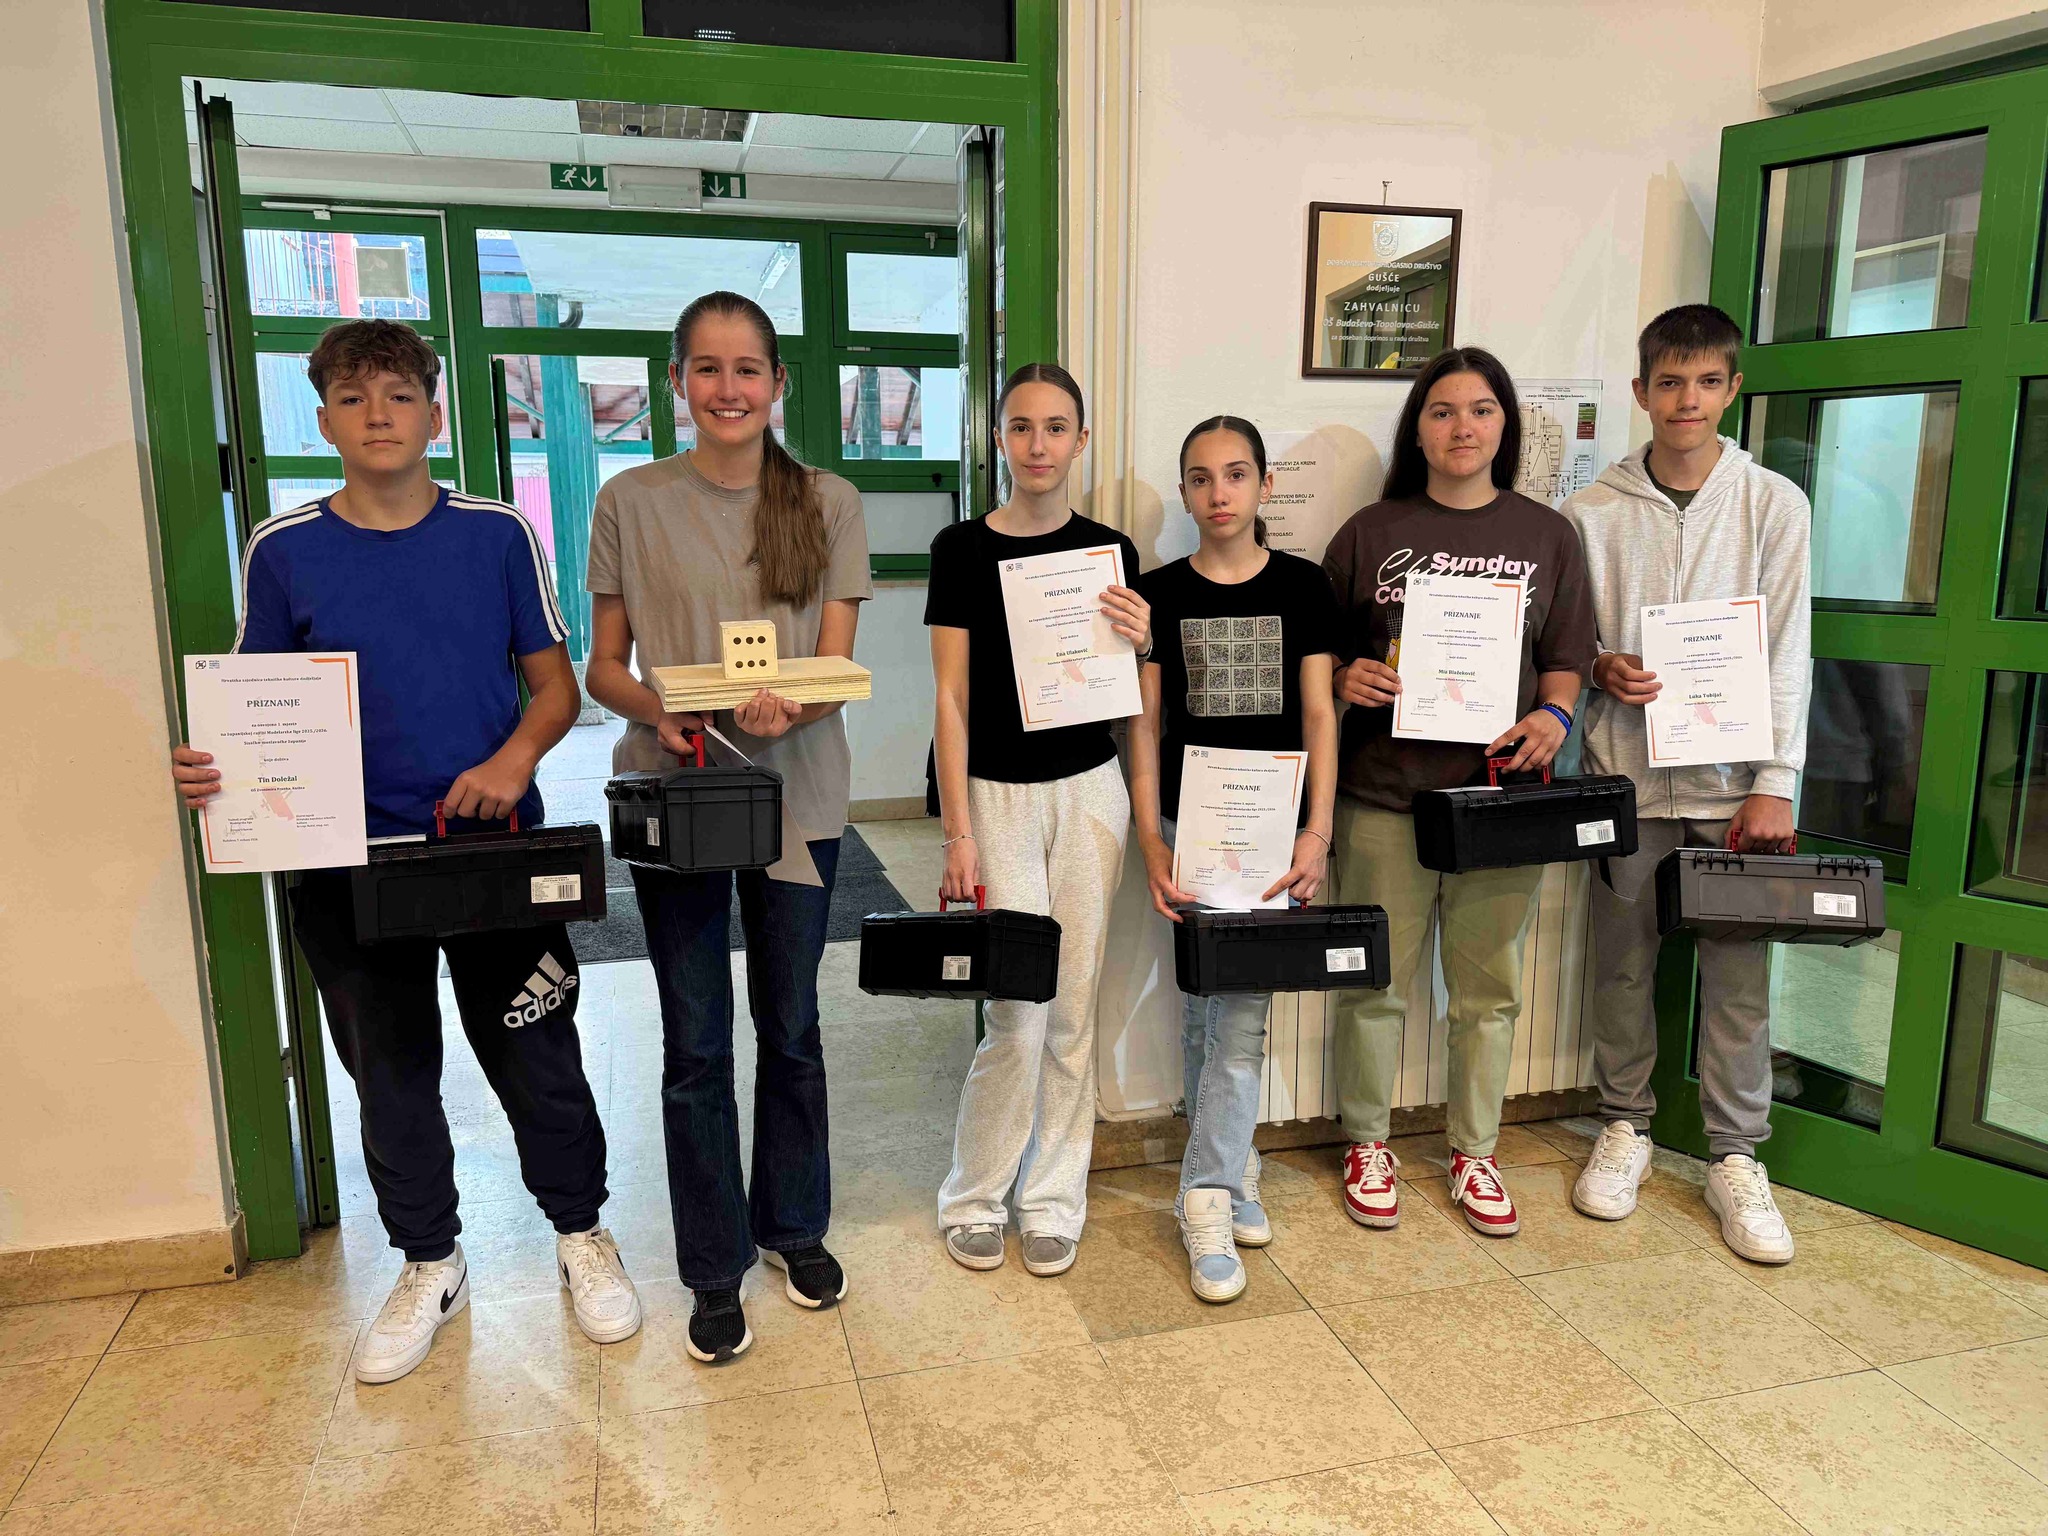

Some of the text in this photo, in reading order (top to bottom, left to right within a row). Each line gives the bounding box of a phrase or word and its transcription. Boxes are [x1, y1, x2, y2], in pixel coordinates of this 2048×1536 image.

[1368, 272, 1400, 282] GUŠĆE
[1366, 284, 1400, 293] dodjeljuje
[1344, 302, 1420, 312] ZAHVALNICU
[1322, 317, 1333, 326] OŠ
[1430, 552, 1538, 580] Sunday
[1044, 586, 1083, 598] PRIZNANJE
[1444, 610, 1482, 620] PRIZNANJE
[1683, 634, 1723, 643] PRIZNANJE
[246, 698, 301, 708] PRIZNANJE
[1222, 784, 1262, 792] PRIZNANJE
